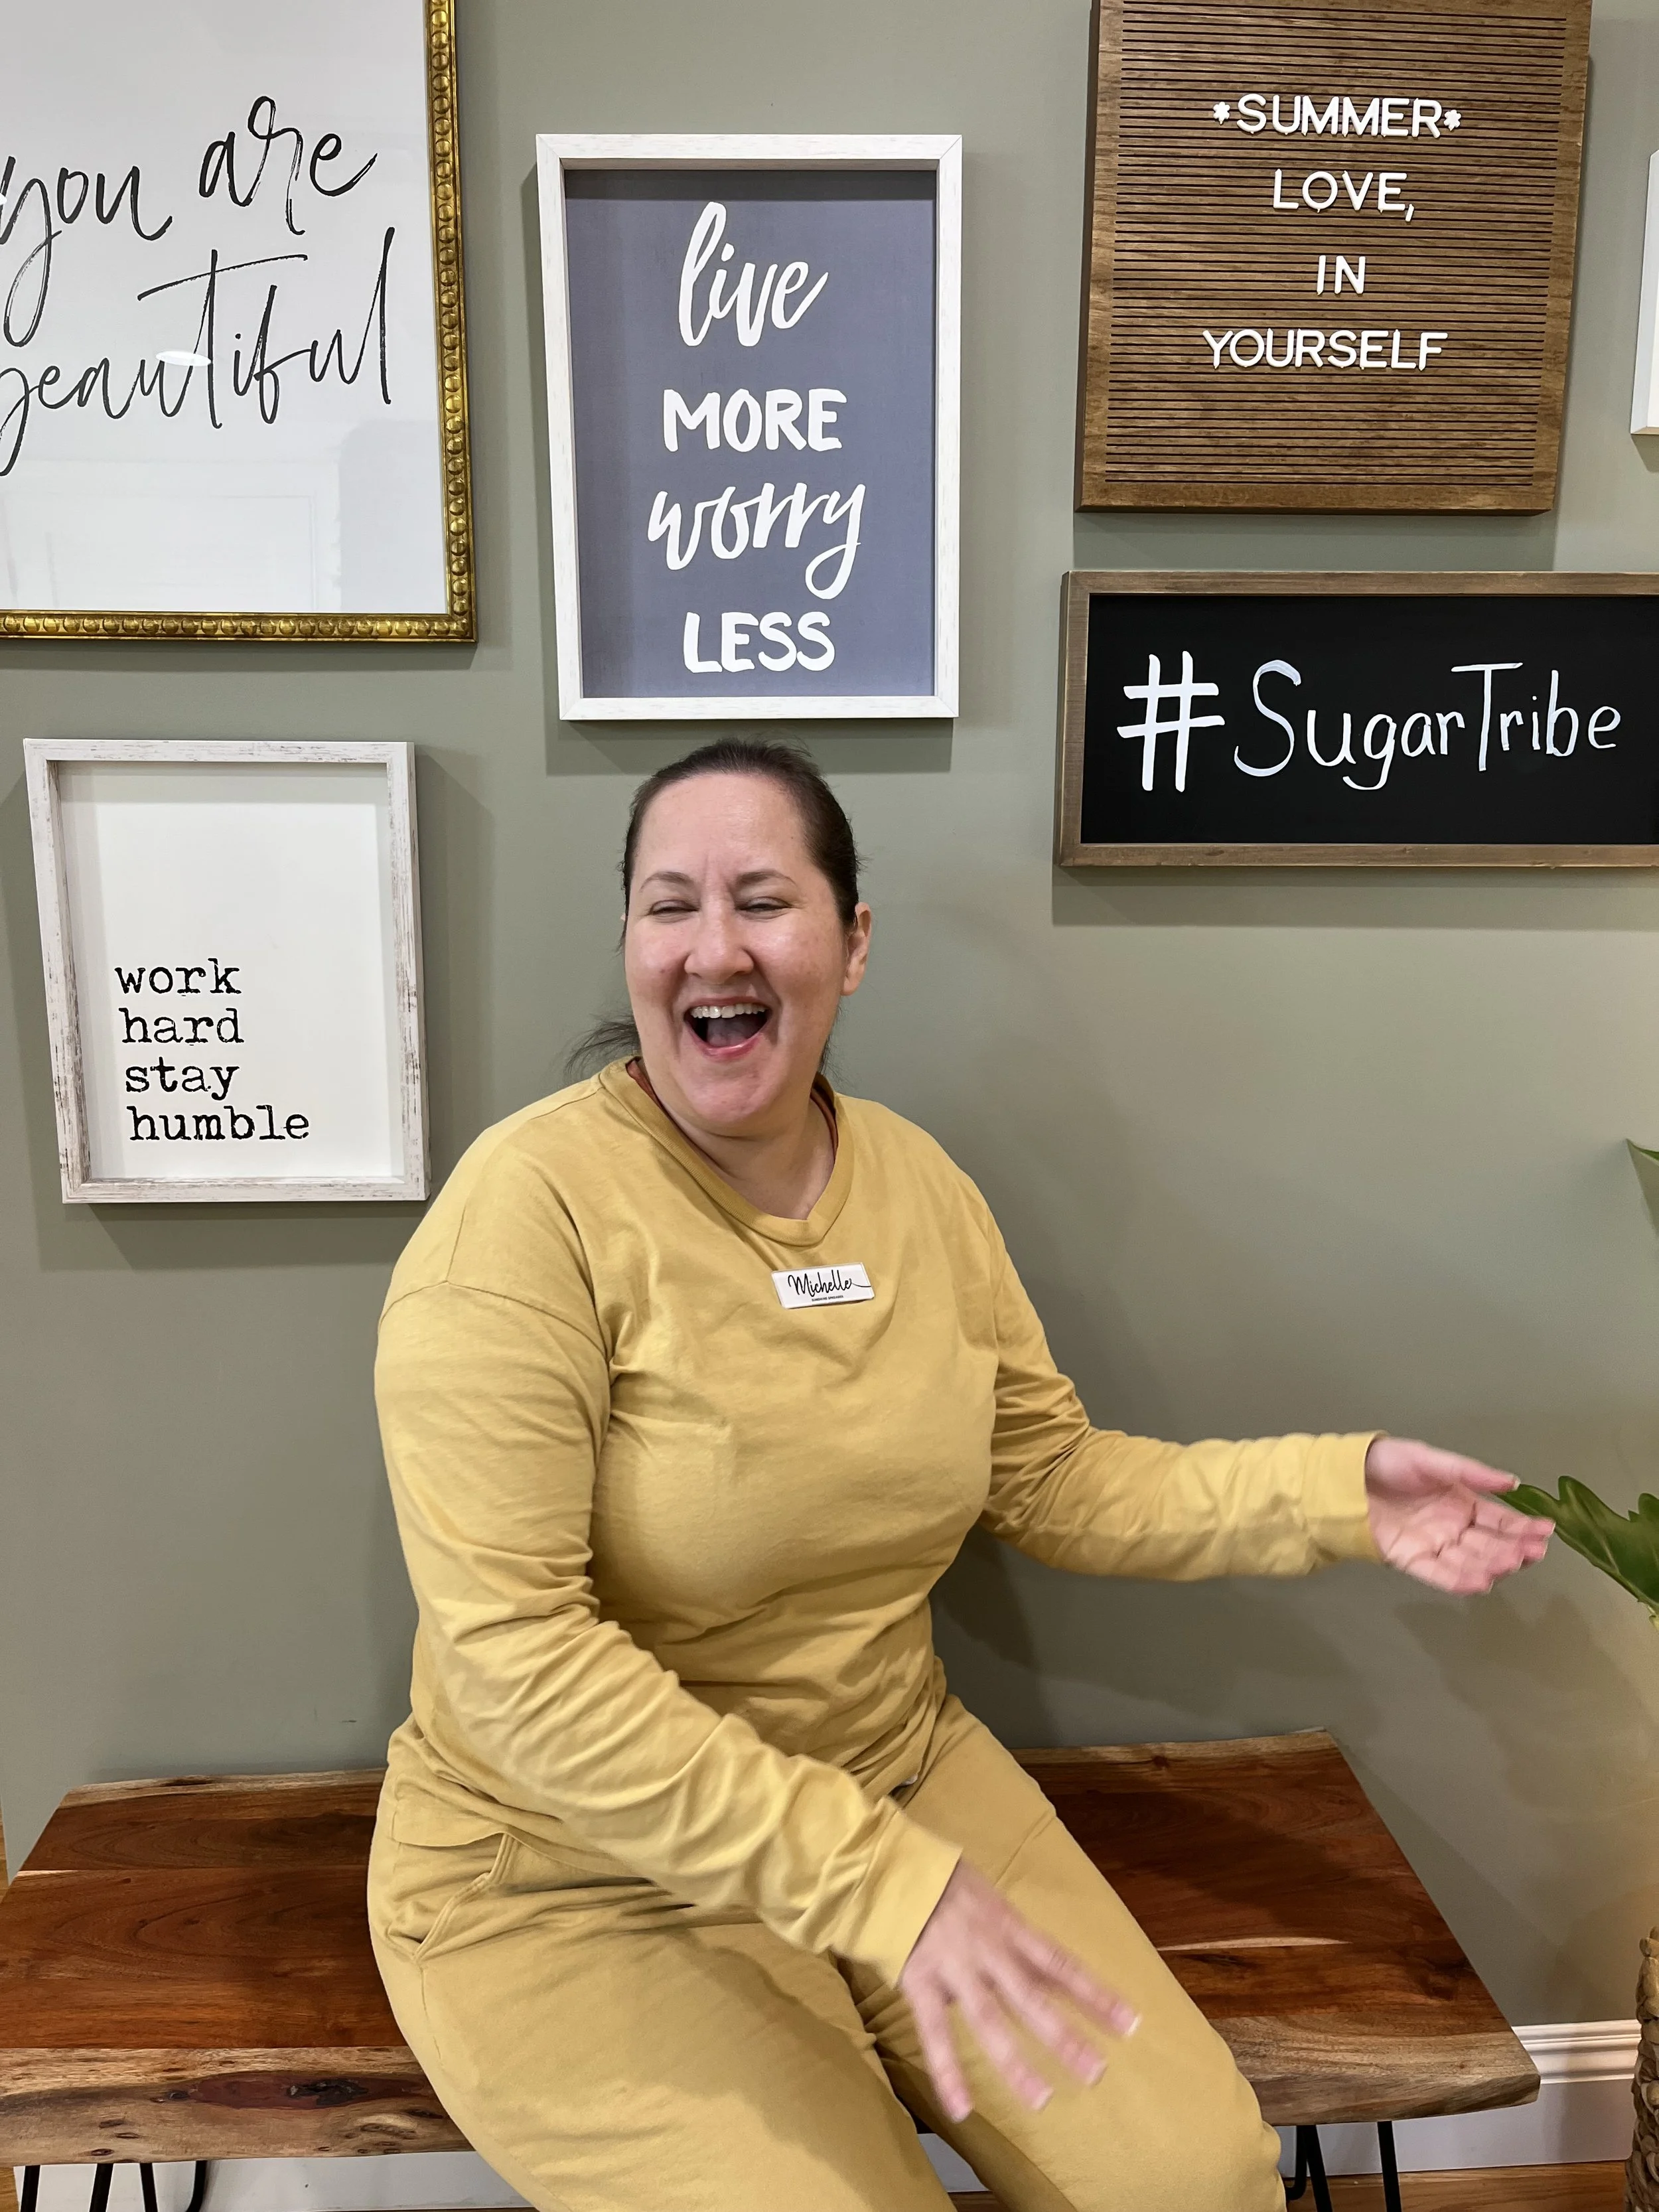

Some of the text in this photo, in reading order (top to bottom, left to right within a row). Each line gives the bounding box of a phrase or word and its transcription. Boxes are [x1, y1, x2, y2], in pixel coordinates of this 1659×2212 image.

[199, 96, 378, 235] are
[1273, 169, 1415, 222] LOVE,
[678, 201, 829, 347] live
[1317, 255, 1366, 295] IN
[1202, 328, 1448, 371] YOURSELF
[664, 388, 847, 453] MORE
[647, 482, 866, 600] worry
[683, 611, 835, 674] LESS
[1116, 650, 1621, 792] #SugarTribe
[114, 958, 242, 995] work
[118, 1007, 245, 1045] hard
[125, 1056, 240, 1101] stay
[126, 1104, 310, 1141] humble
[788, 1269, 871, 1297] Michelle
